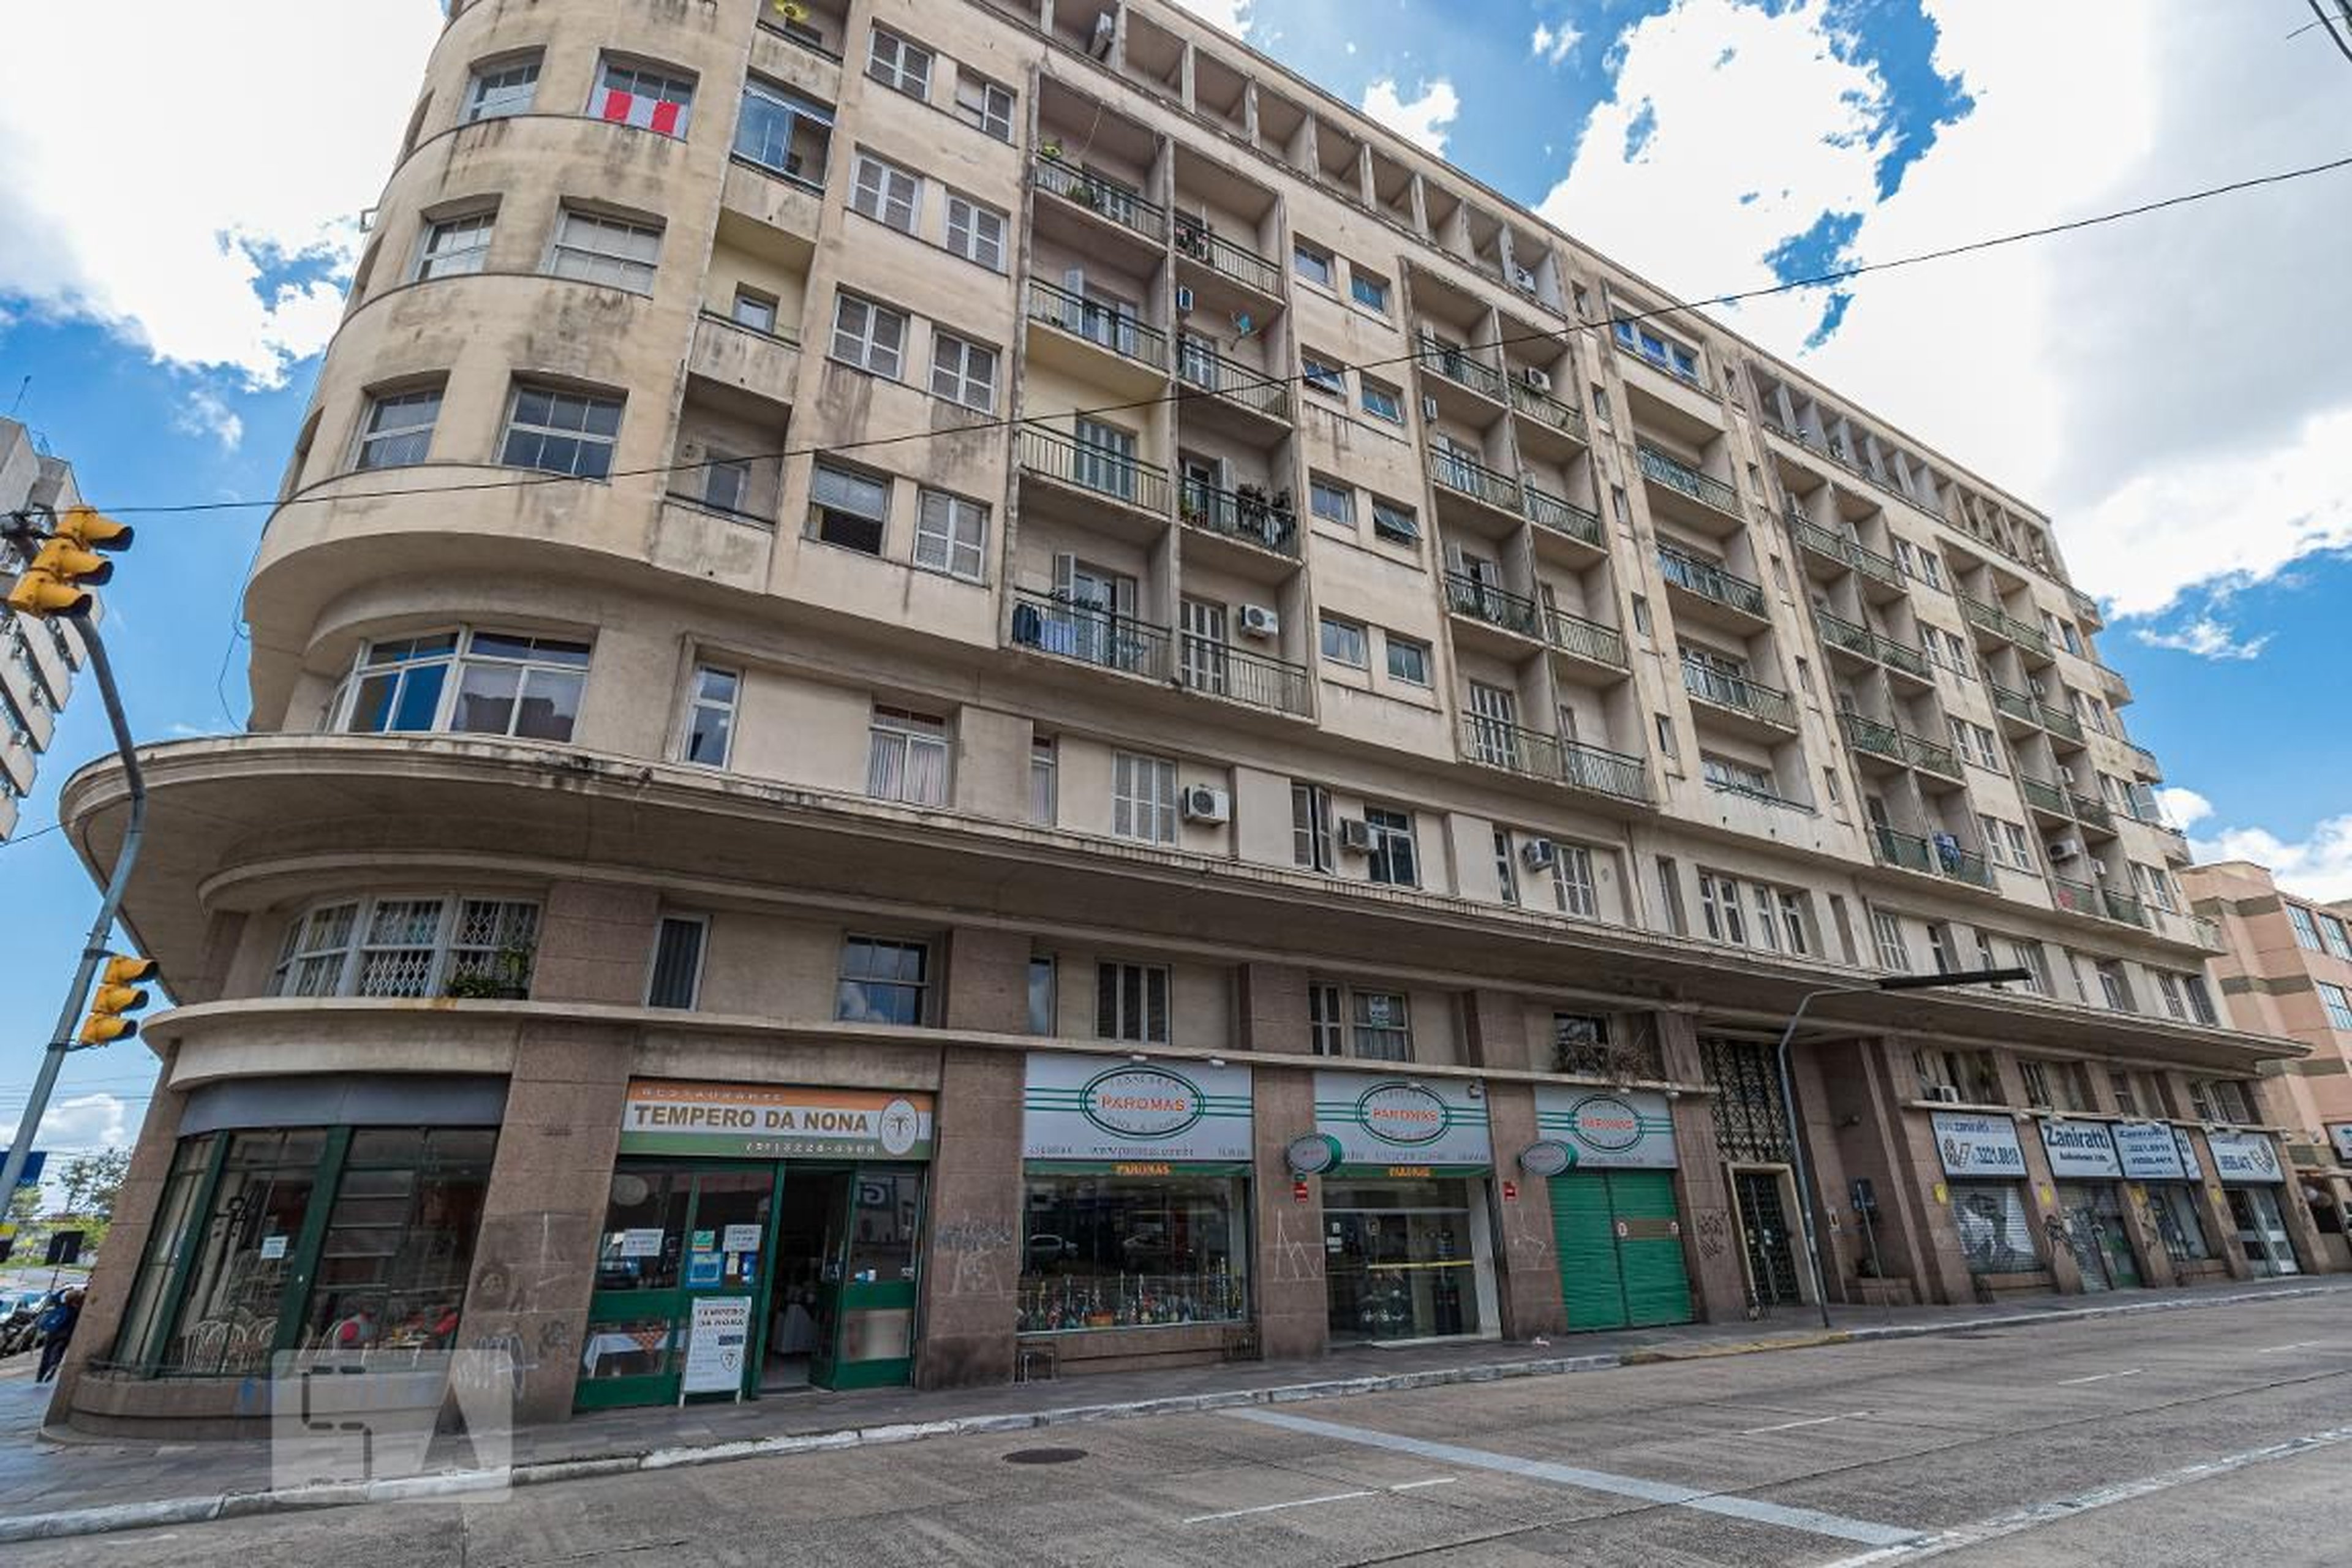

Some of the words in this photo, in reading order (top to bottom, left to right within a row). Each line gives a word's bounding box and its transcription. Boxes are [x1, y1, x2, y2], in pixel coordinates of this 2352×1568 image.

[634, 1104, 756, 1128] TEMPERO
[764, 1110, 796, 1129] DA
[803, 1112, 869, 1133] NONA
[2043, 1125, 2111, 1150] Zaniratti
